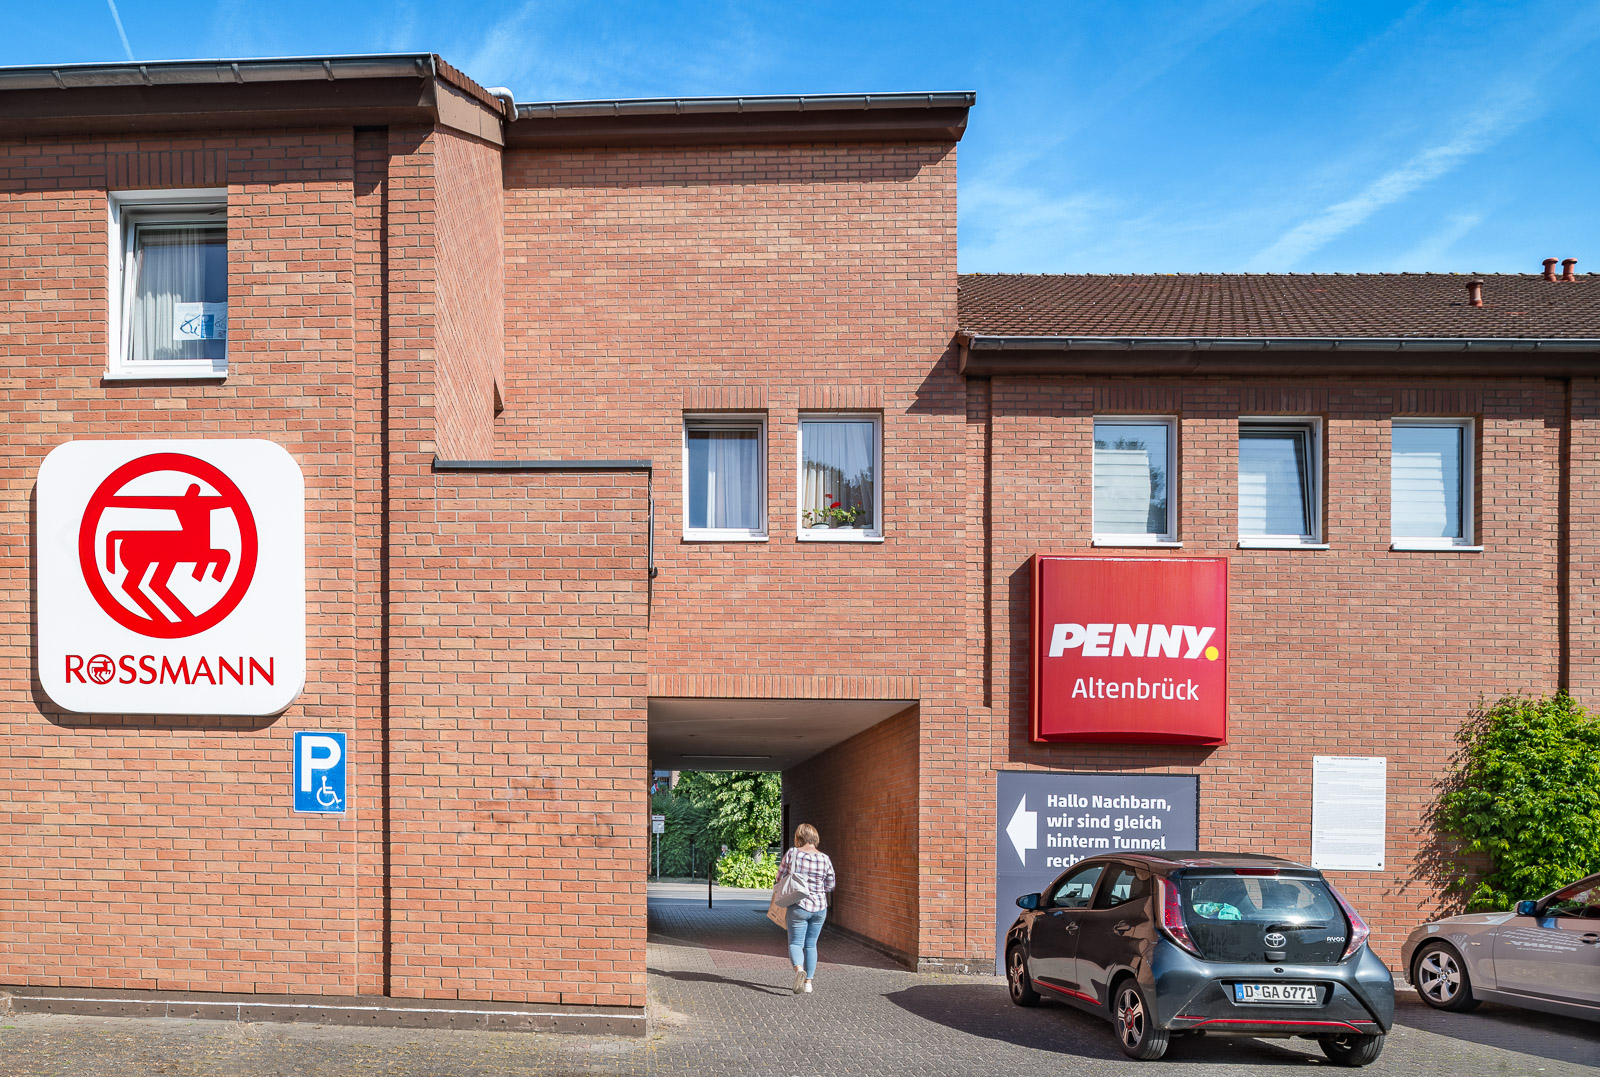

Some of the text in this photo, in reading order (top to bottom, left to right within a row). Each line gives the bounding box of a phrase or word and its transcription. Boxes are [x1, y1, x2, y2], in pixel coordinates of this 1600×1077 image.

[65, 654, 275, 686] ROSSMANN
[1071, 676, 1200, 701] Altenbrück
[301, 735, 342, 792] P
[1047, 794, 1172, 812] Hallo Nachbarn,
[1046, 813, 1162, 832] wir sind gleich
[1047, 833, 1167, 850] hinterm Tunnel
[1262, 986, 1280, 999] GA
[1283, 986, 1316, 1000] 6771
